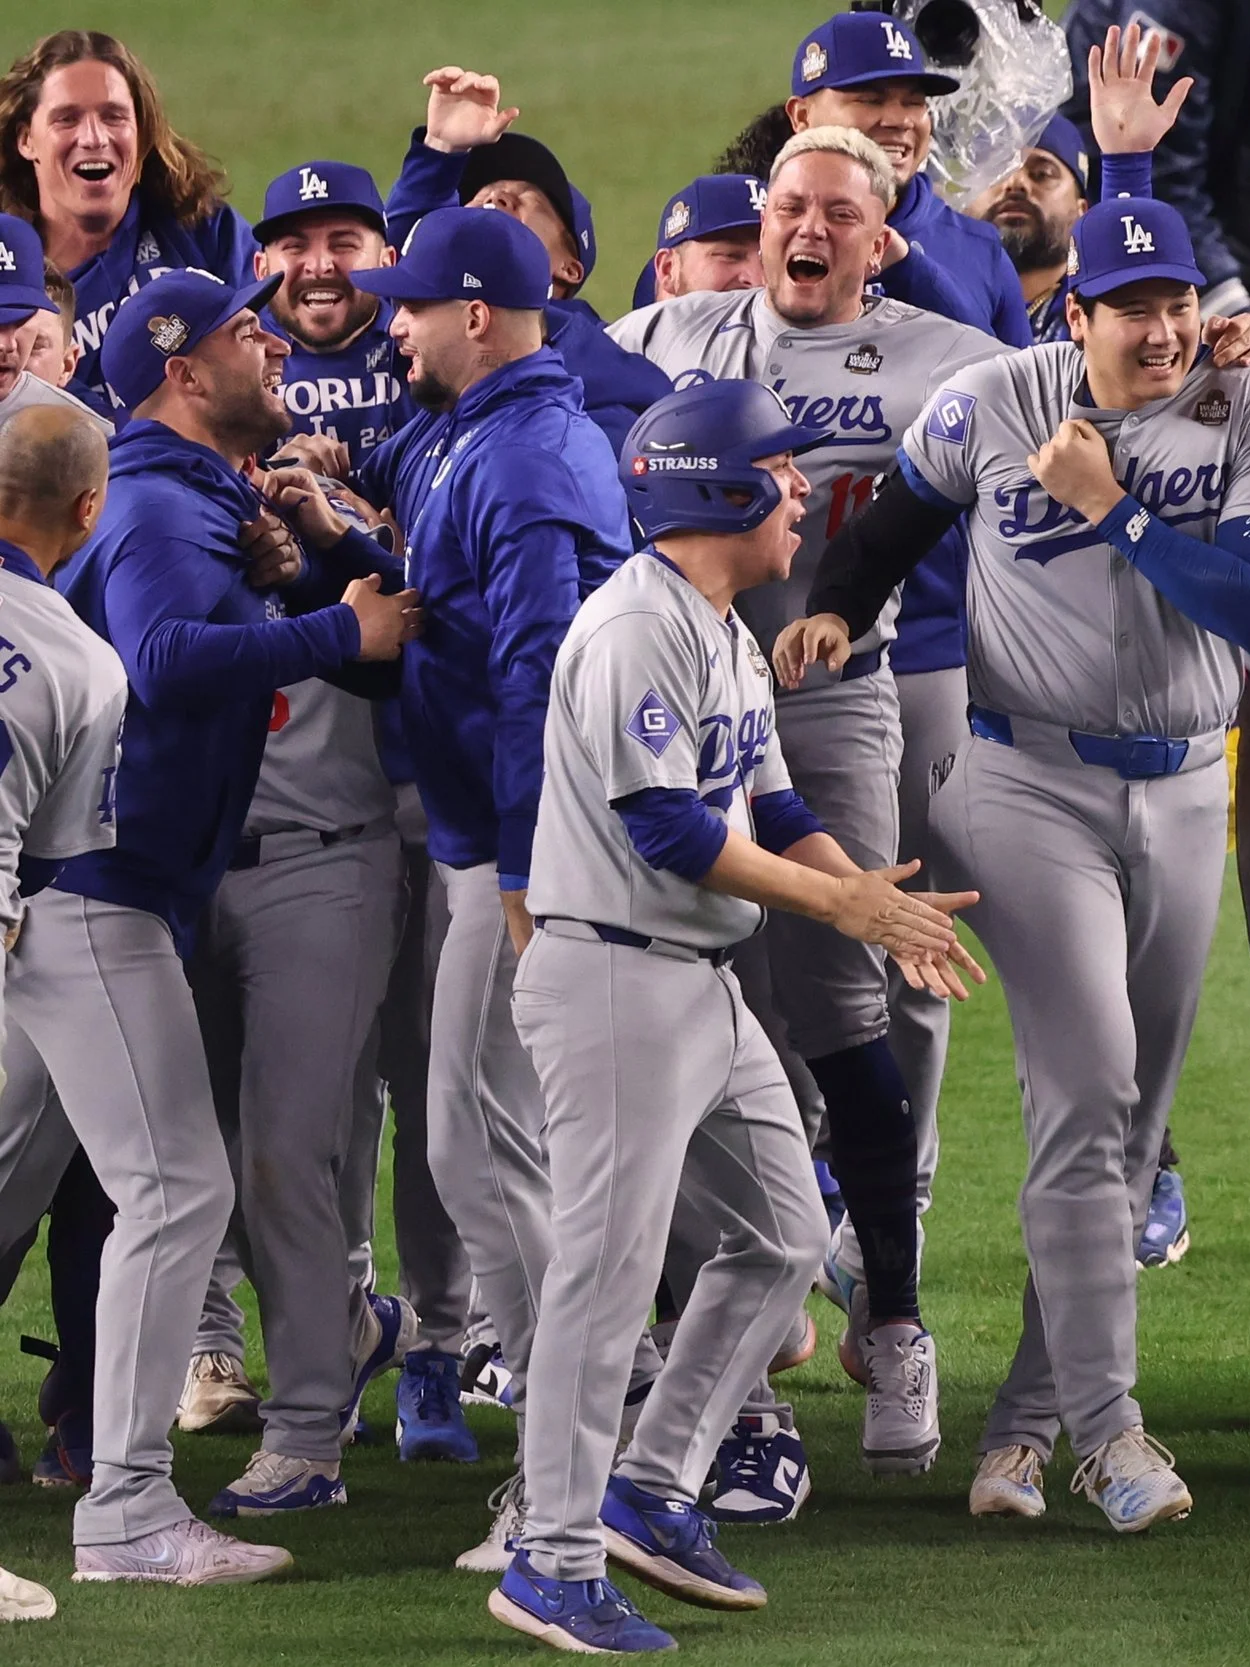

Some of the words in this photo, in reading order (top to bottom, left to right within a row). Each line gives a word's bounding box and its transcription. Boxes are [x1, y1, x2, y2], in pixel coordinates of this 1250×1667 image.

[881, 22, 912, 60] LA
[299, 167, 328, 200] LA
[1120, 215, 1155, 254] LA
[648, 457, 718, 471] STRAUSS
